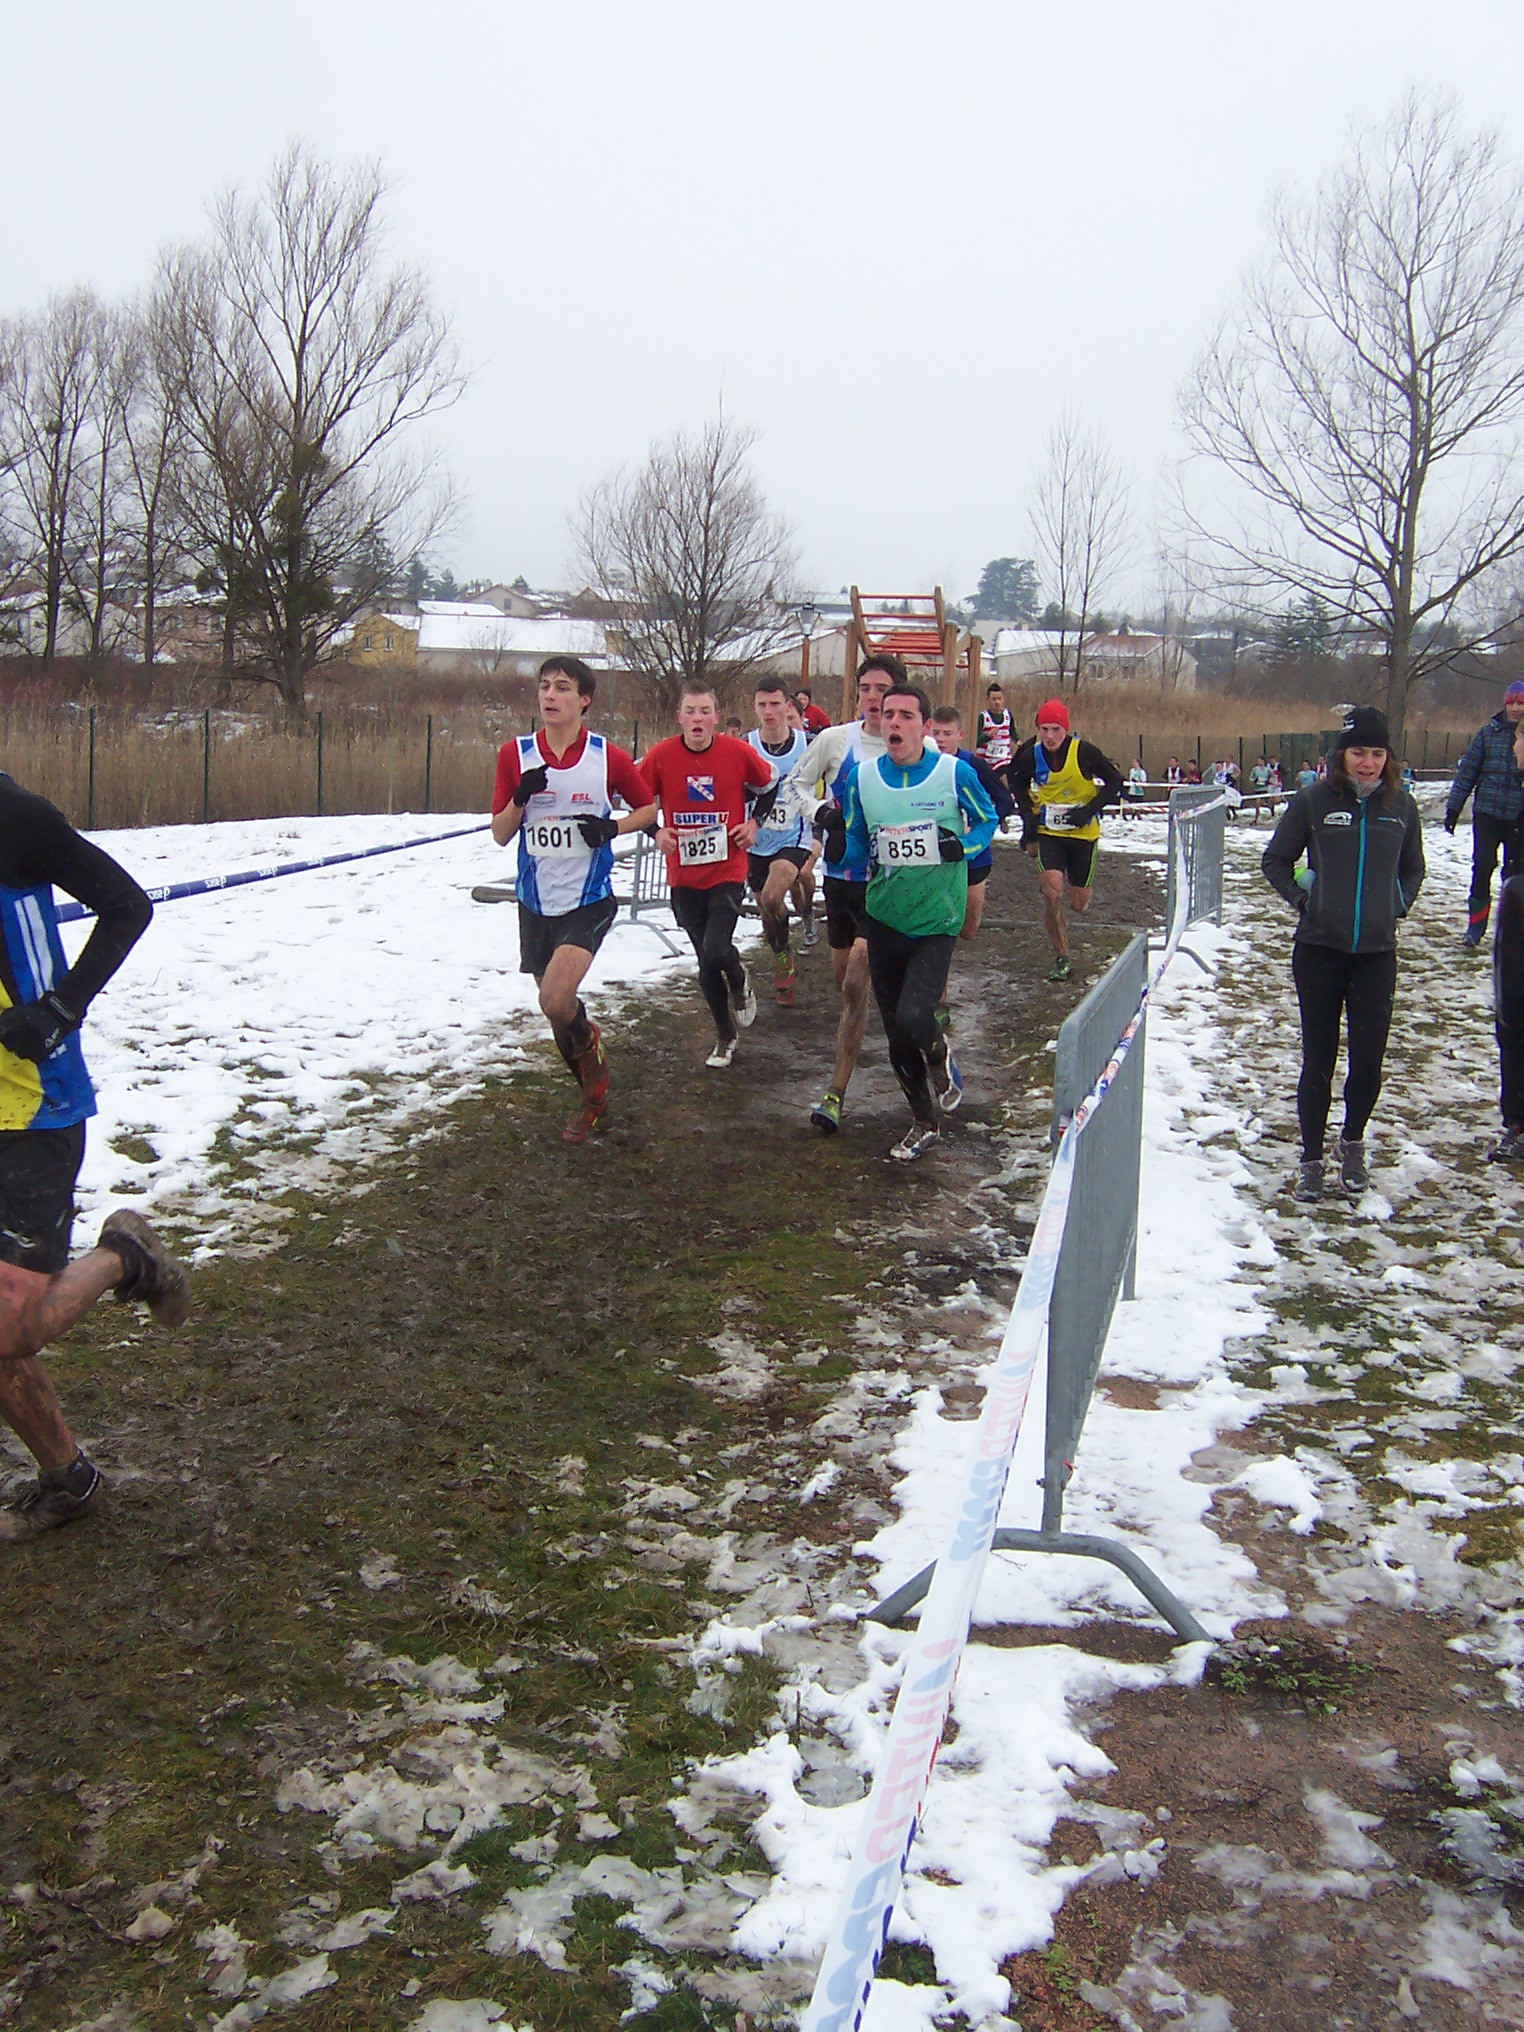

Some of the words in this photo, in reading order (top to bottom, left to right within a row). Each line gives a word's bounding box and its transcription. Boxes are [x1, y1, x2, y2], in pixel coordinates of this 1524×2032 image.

[674, 814, 717, 824] SUPER
[719, 813, 729, 824] U
[527, 826, 571, 848] 1601
[680, 837, 716, 858] 1825
[888, 838, 926, 859] 855
